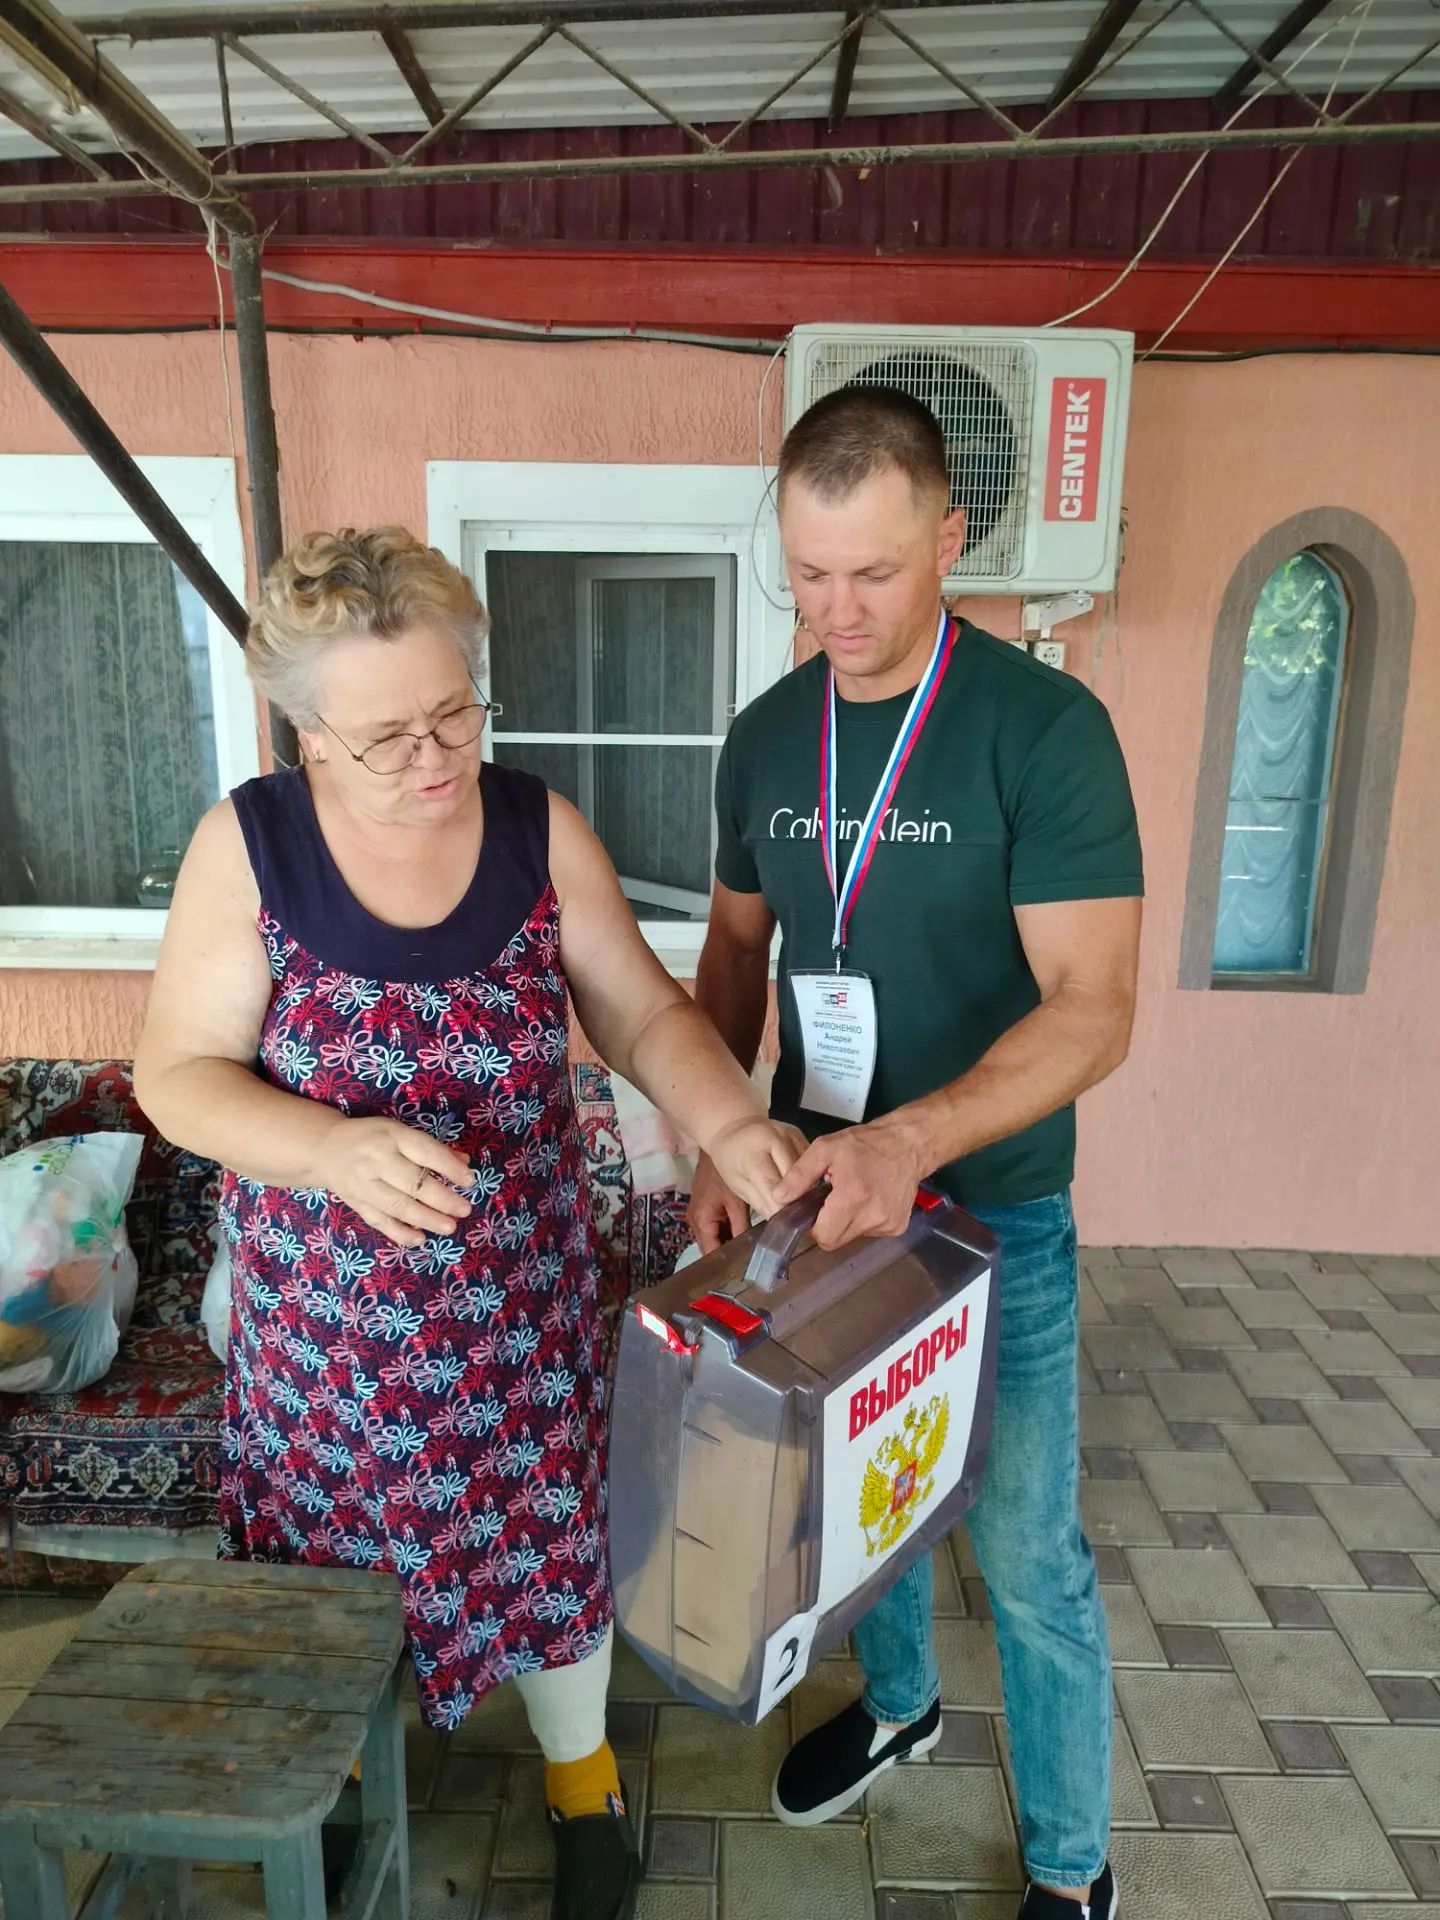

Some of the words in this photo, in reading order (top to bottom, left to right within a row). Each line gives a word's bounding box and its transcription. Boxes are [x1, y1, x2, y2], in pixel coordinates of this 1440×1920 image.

[1059, 390, 1091, 519] CENTEK
[812, 1020, 862, 1034] ФИЛОНЕНКО
[849, 1304, 969, 1443] ВЫБОРЫ
[773, 1637, 800, 1692] 2
